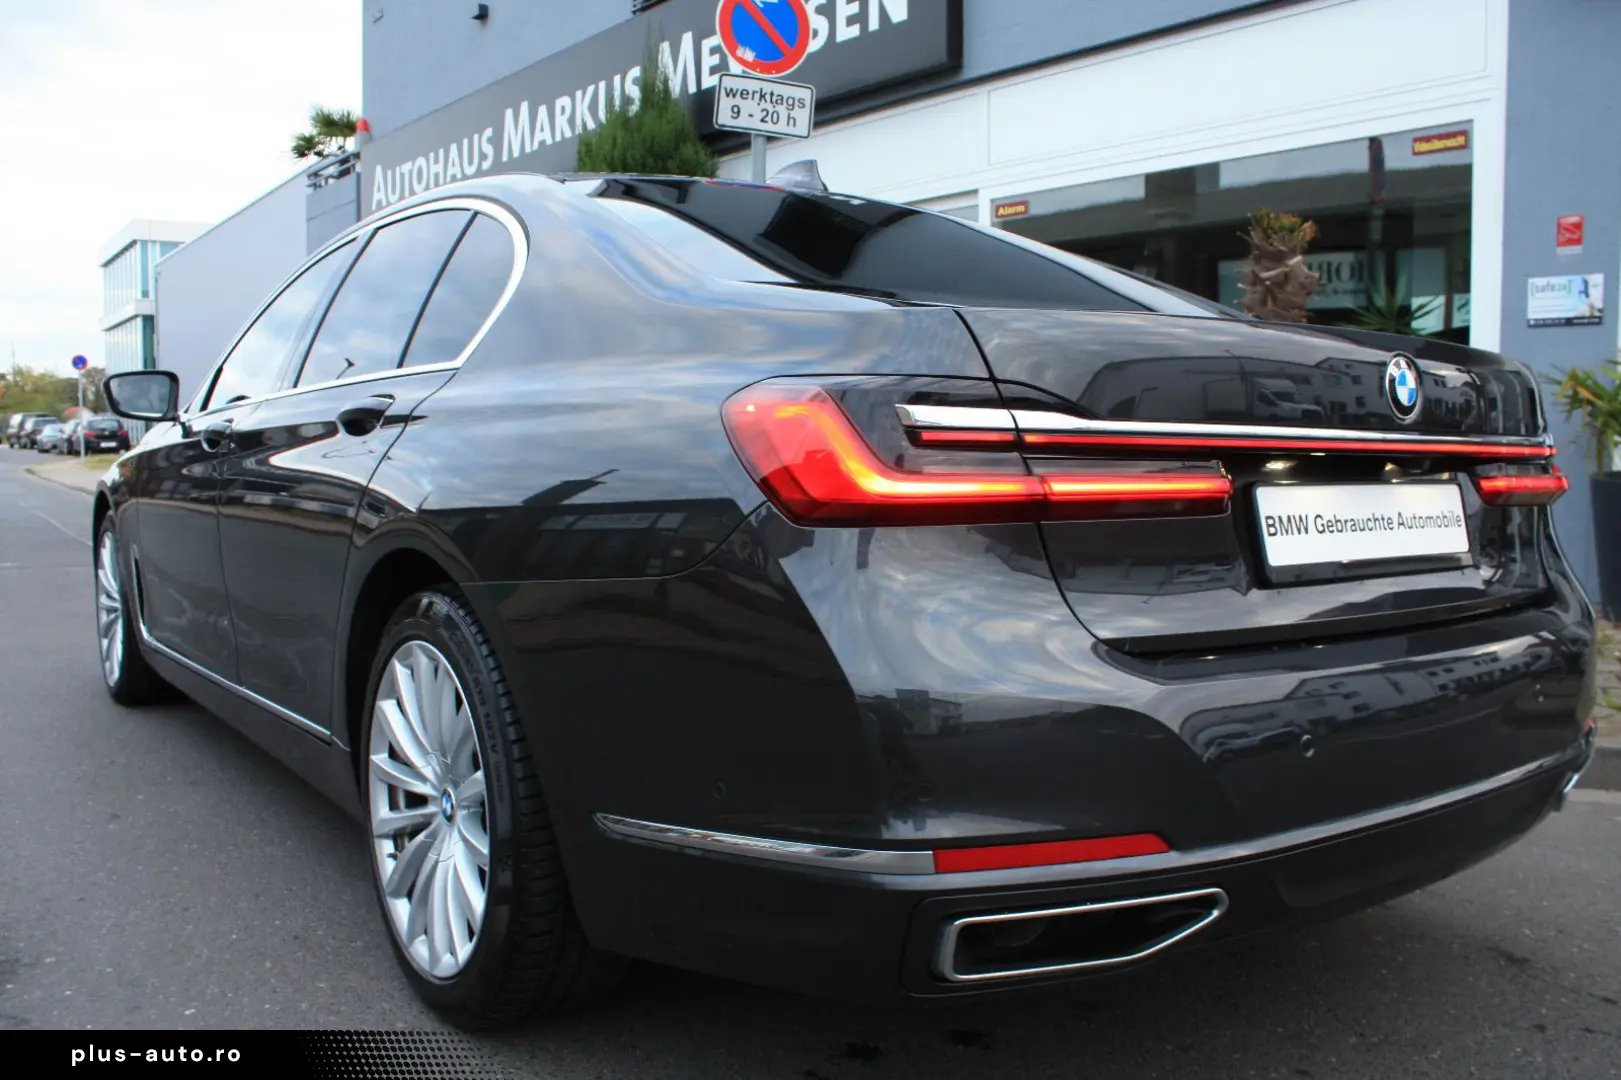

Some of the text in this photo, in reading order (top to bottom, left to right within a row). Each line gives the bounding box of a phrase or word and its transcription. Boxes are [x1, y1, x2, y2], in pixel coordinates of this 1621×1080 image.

[724, 86, 806, 111] werktags
[730, 104, 741, 120] 9
[759, 108, 780, 125] 20
[786, 112, 797, 128] h
[1265, 510, 1462, 537] BMW Gebrauchte Automobile
